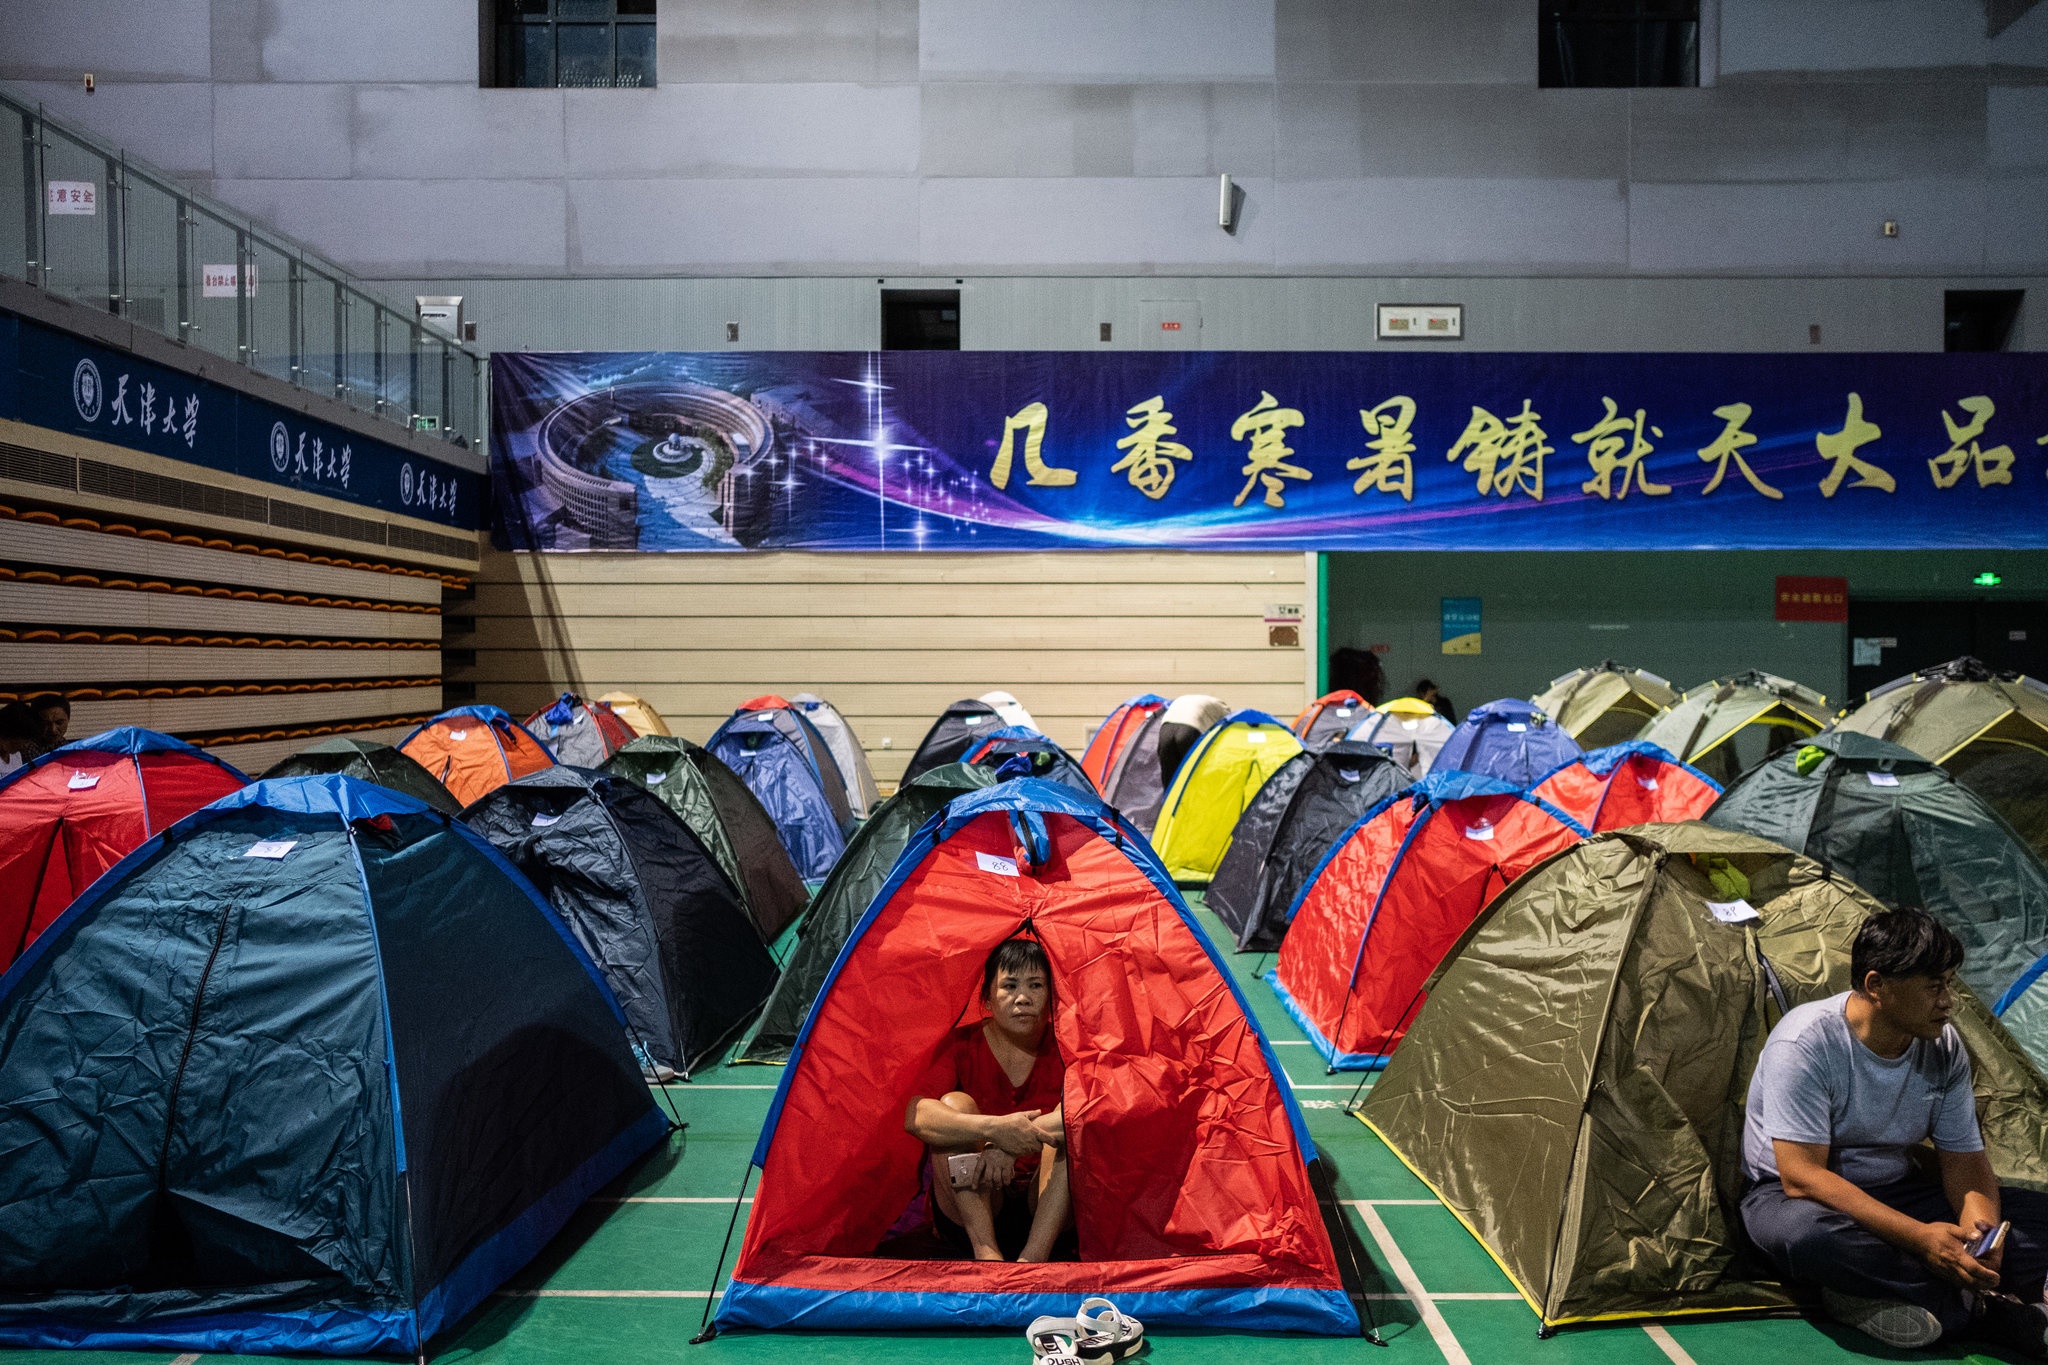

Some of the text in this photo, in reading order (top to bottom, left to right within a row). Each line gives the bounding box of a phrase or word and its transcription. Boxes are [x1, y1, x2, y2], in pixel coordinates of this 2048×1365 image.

[111, 373, 200, 449] 天津大学
[295, 431, 351, 489] 天津大学
[989, 390, 2048, 509] 几番寒暑铸就天大品
[416, 469, 458, 516] 天津大学
